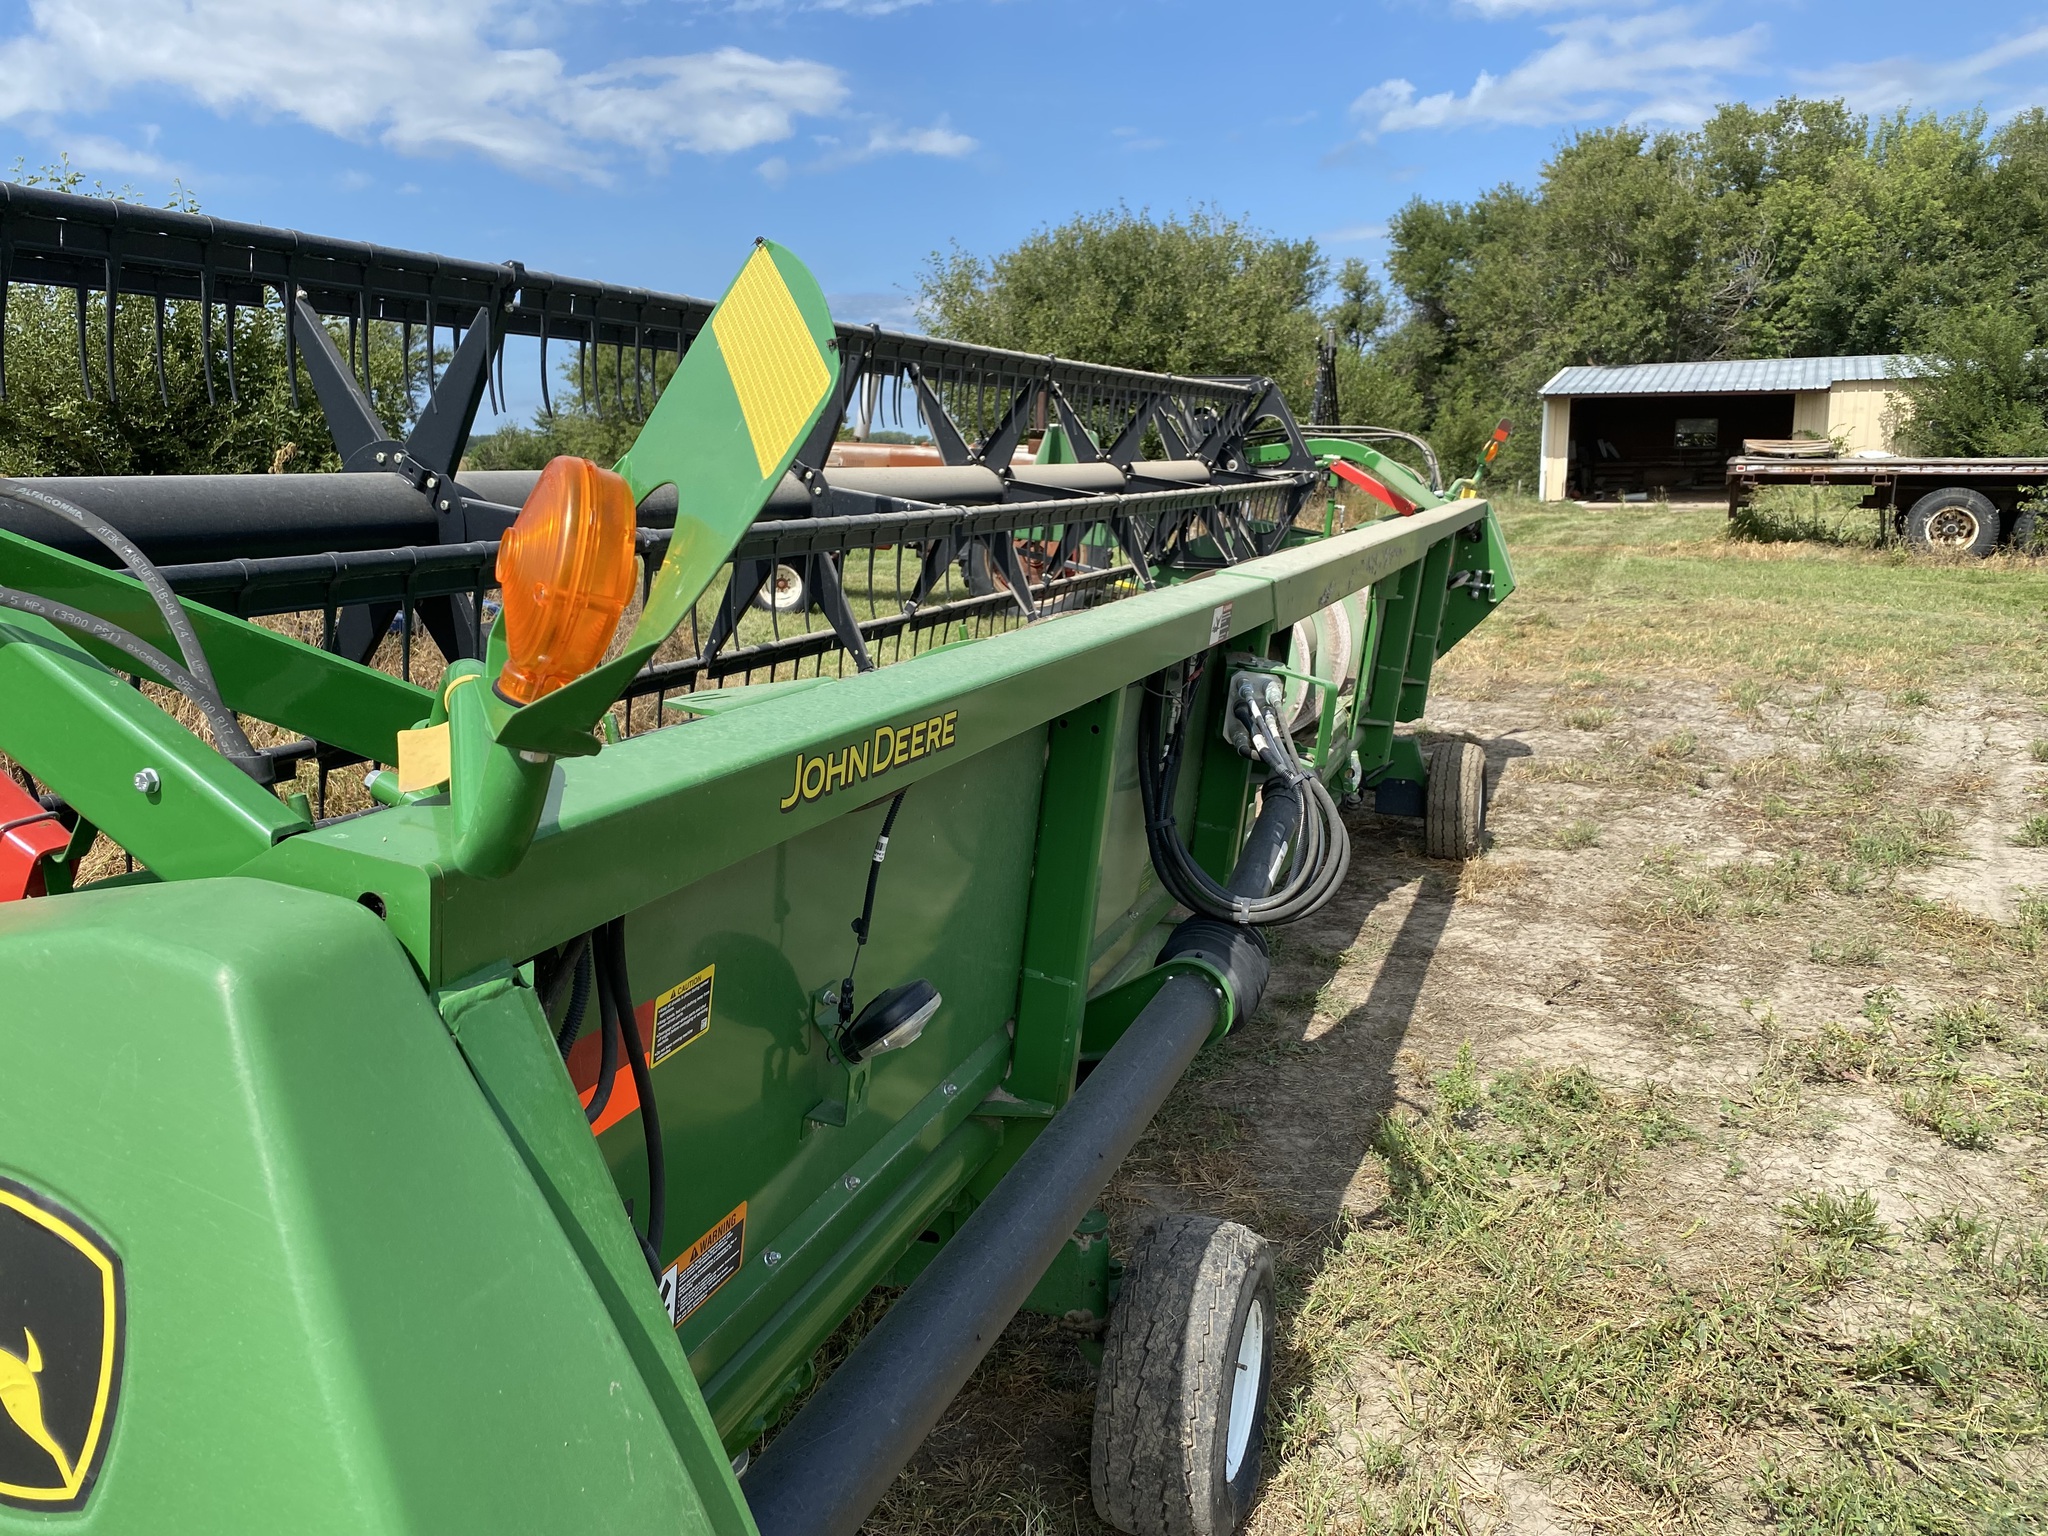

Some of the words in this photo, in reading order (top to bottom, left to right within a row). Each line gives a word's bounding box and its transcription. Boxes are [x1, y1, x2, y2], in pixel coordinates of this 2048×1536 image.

[15, 487, 83, 520] ALFAGOMMA
[25, 600, 45, 613] MPa
[53, 608, 89, 628] (3300
[93, 624, 121, 642] PSI)
[126, 643, 171, 676] exceeds
[176, 675, 196, 694] SAE
[198, 695, 216, 713] 100
[215, 715, 234, 735] R17
[780, 740, 870, 813] JOHN
[871, 710, 958, 774] DEERE
[677, 974, 703, 995] CAUTION
[699, 1213, 737, 1253] WARNING
